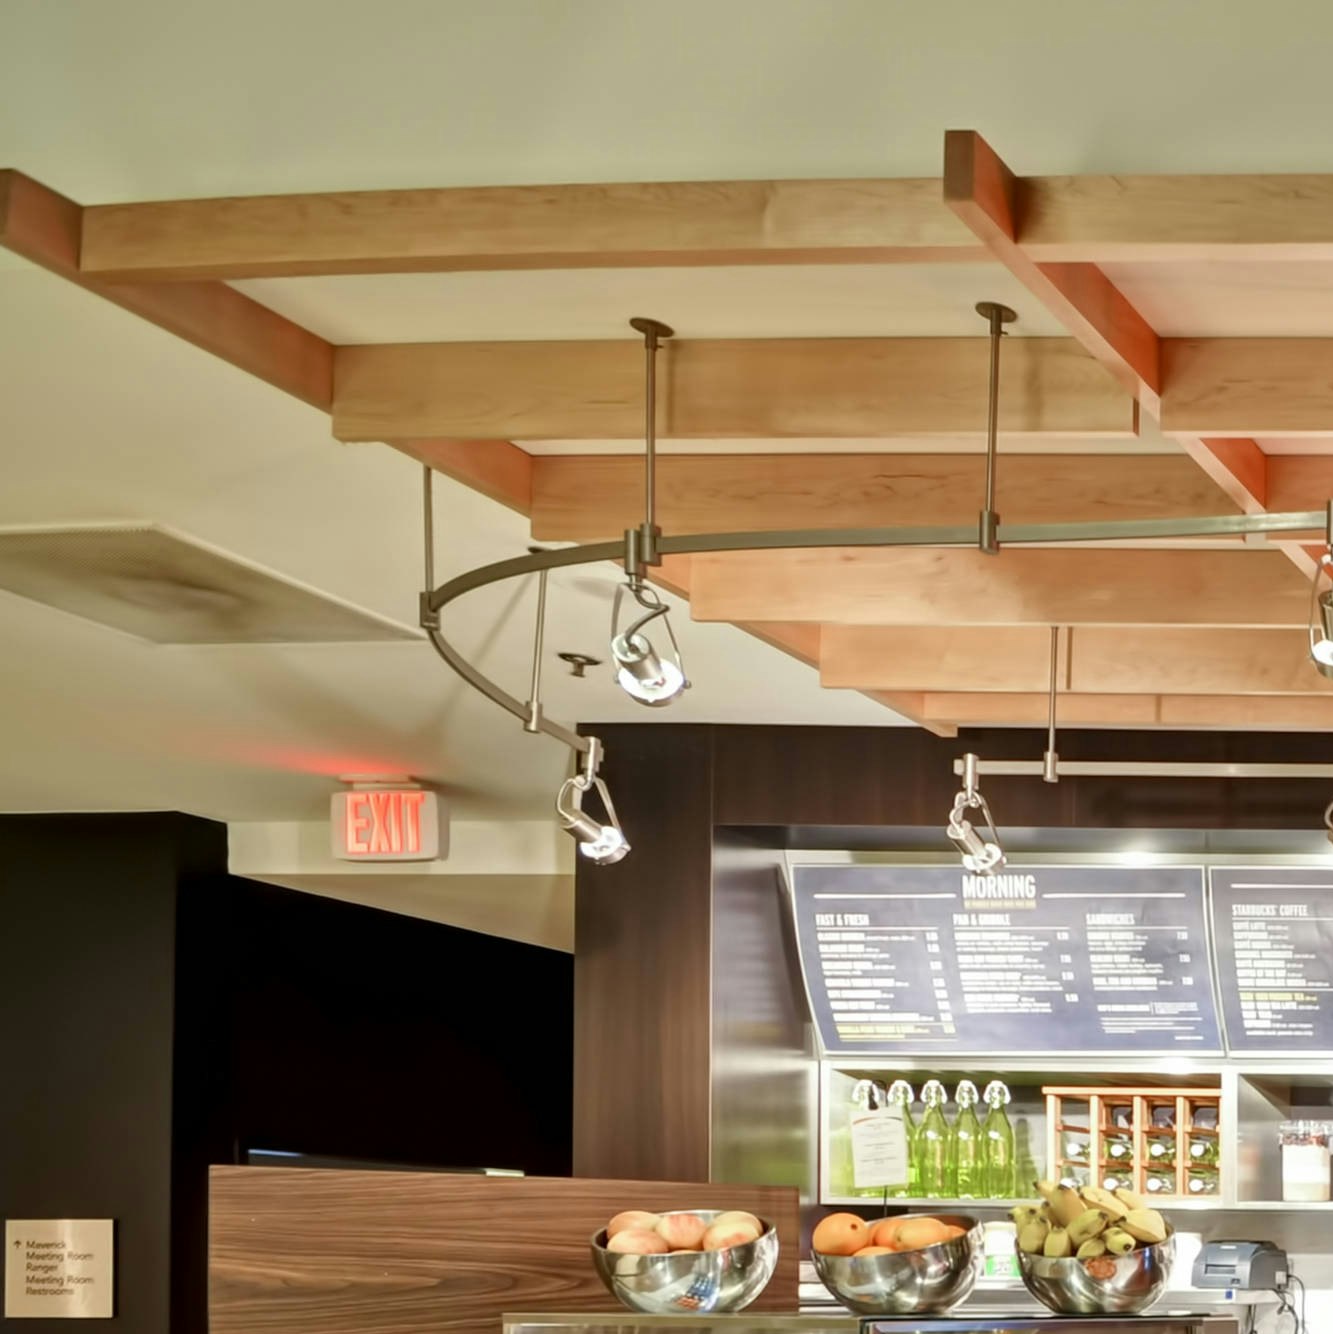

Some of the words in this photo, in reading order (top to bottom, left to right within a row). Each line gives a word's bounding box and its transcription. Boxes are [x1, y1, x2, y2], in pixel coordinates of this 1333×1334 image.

[346, 792, 425, 854] EXIT
[962, 875, 1037, 899] MORNING
[26, 1251, 64, 1262] Meeting
[67, 1252, 94, 1260] Room
[26, 1275, 64, 1286] Meeting
[67, 1275, 95, 1284] Room
